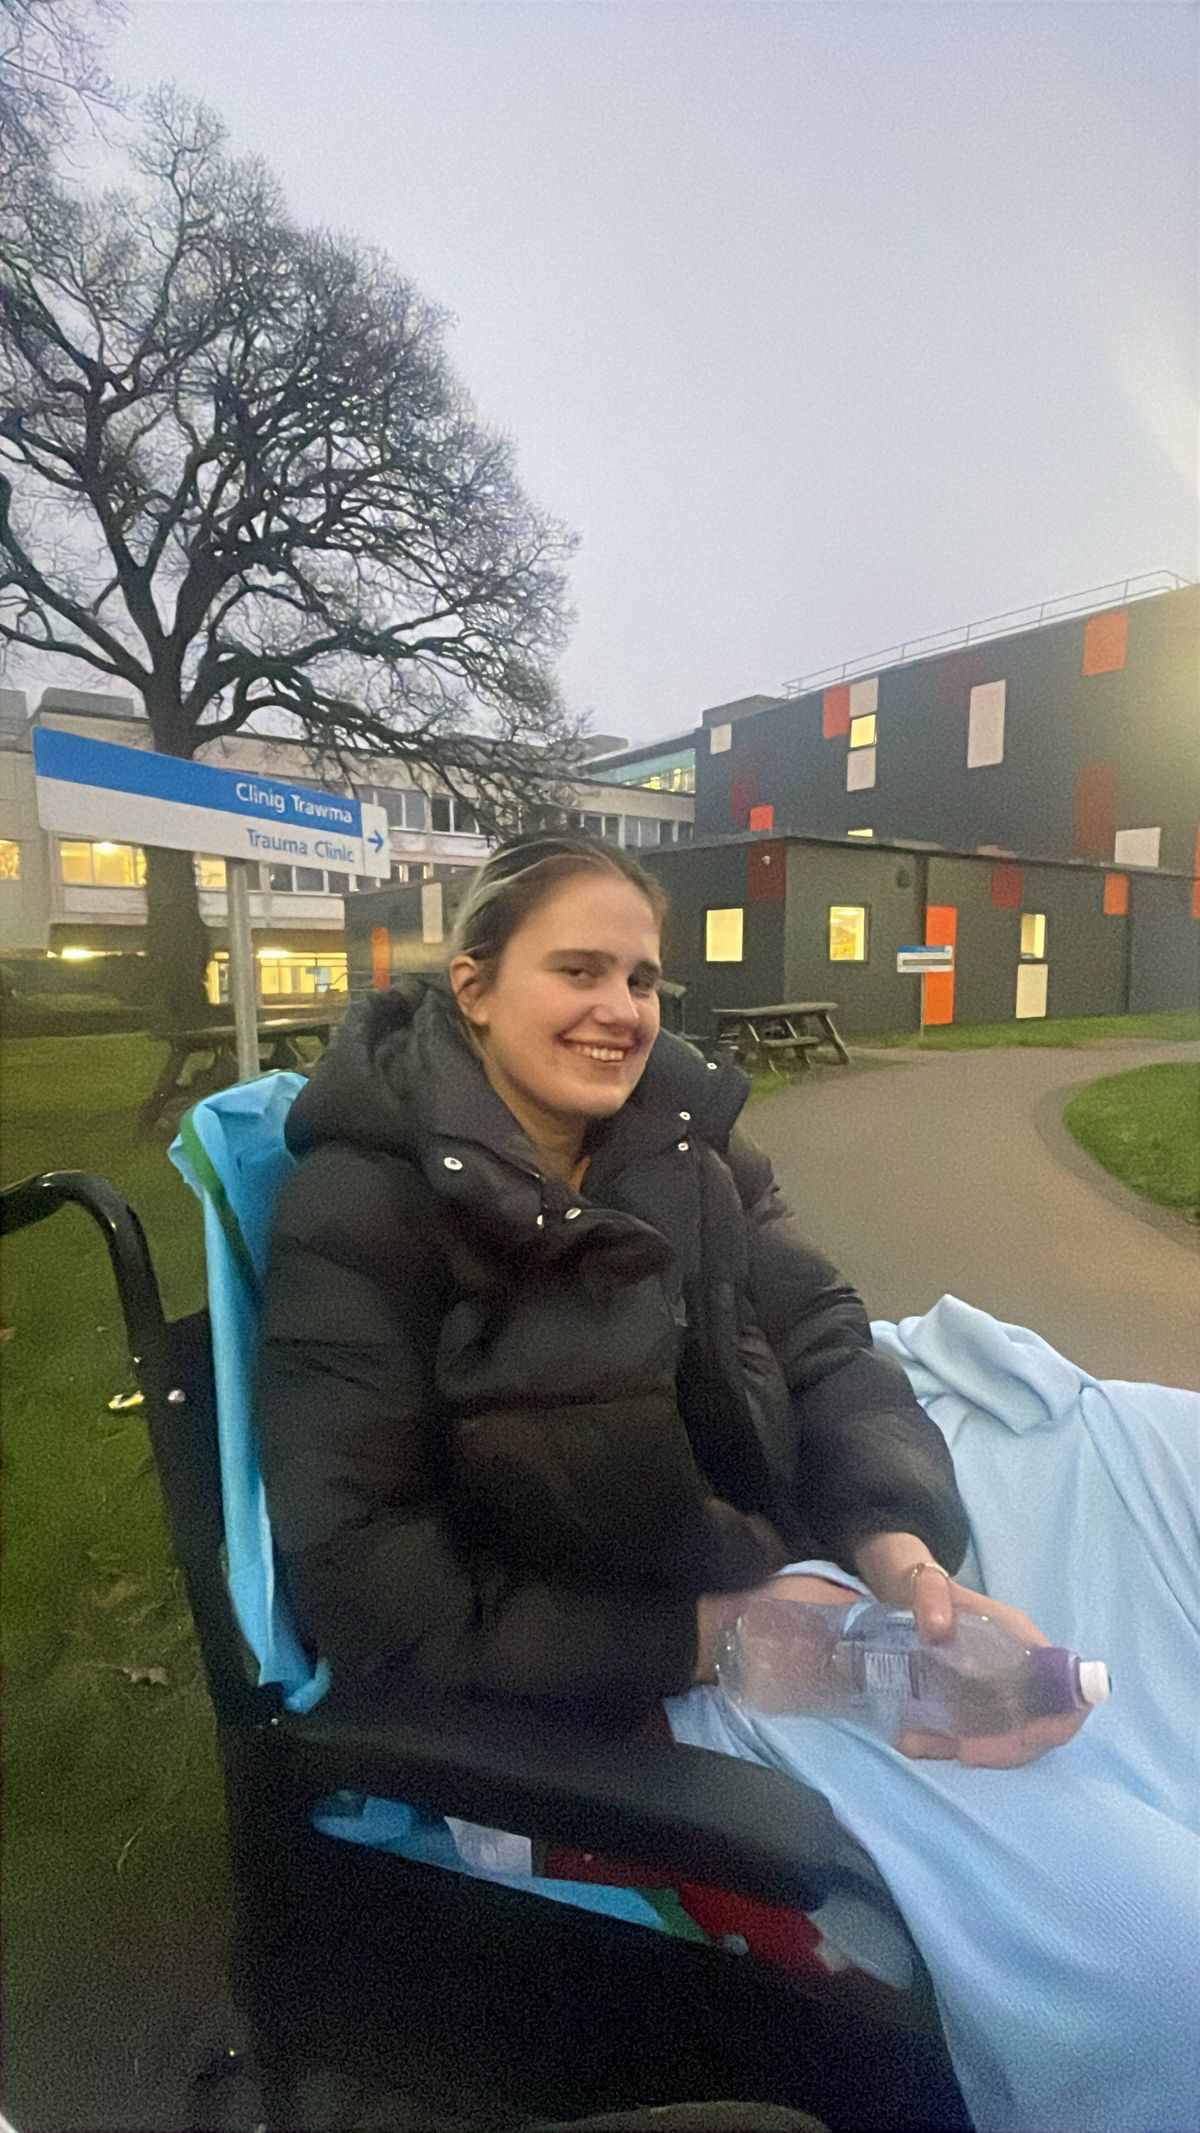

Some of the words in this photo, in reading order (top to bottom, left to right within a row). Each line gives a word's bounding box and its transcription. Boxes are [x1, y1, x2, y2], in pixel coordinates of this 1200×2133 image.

[236, 782, 285, 814] Clinig
[290, 794, 353, 824] Trawma
[246, 828, 308, 855] Trauma
[315, 841, 354, 863] Clinic
